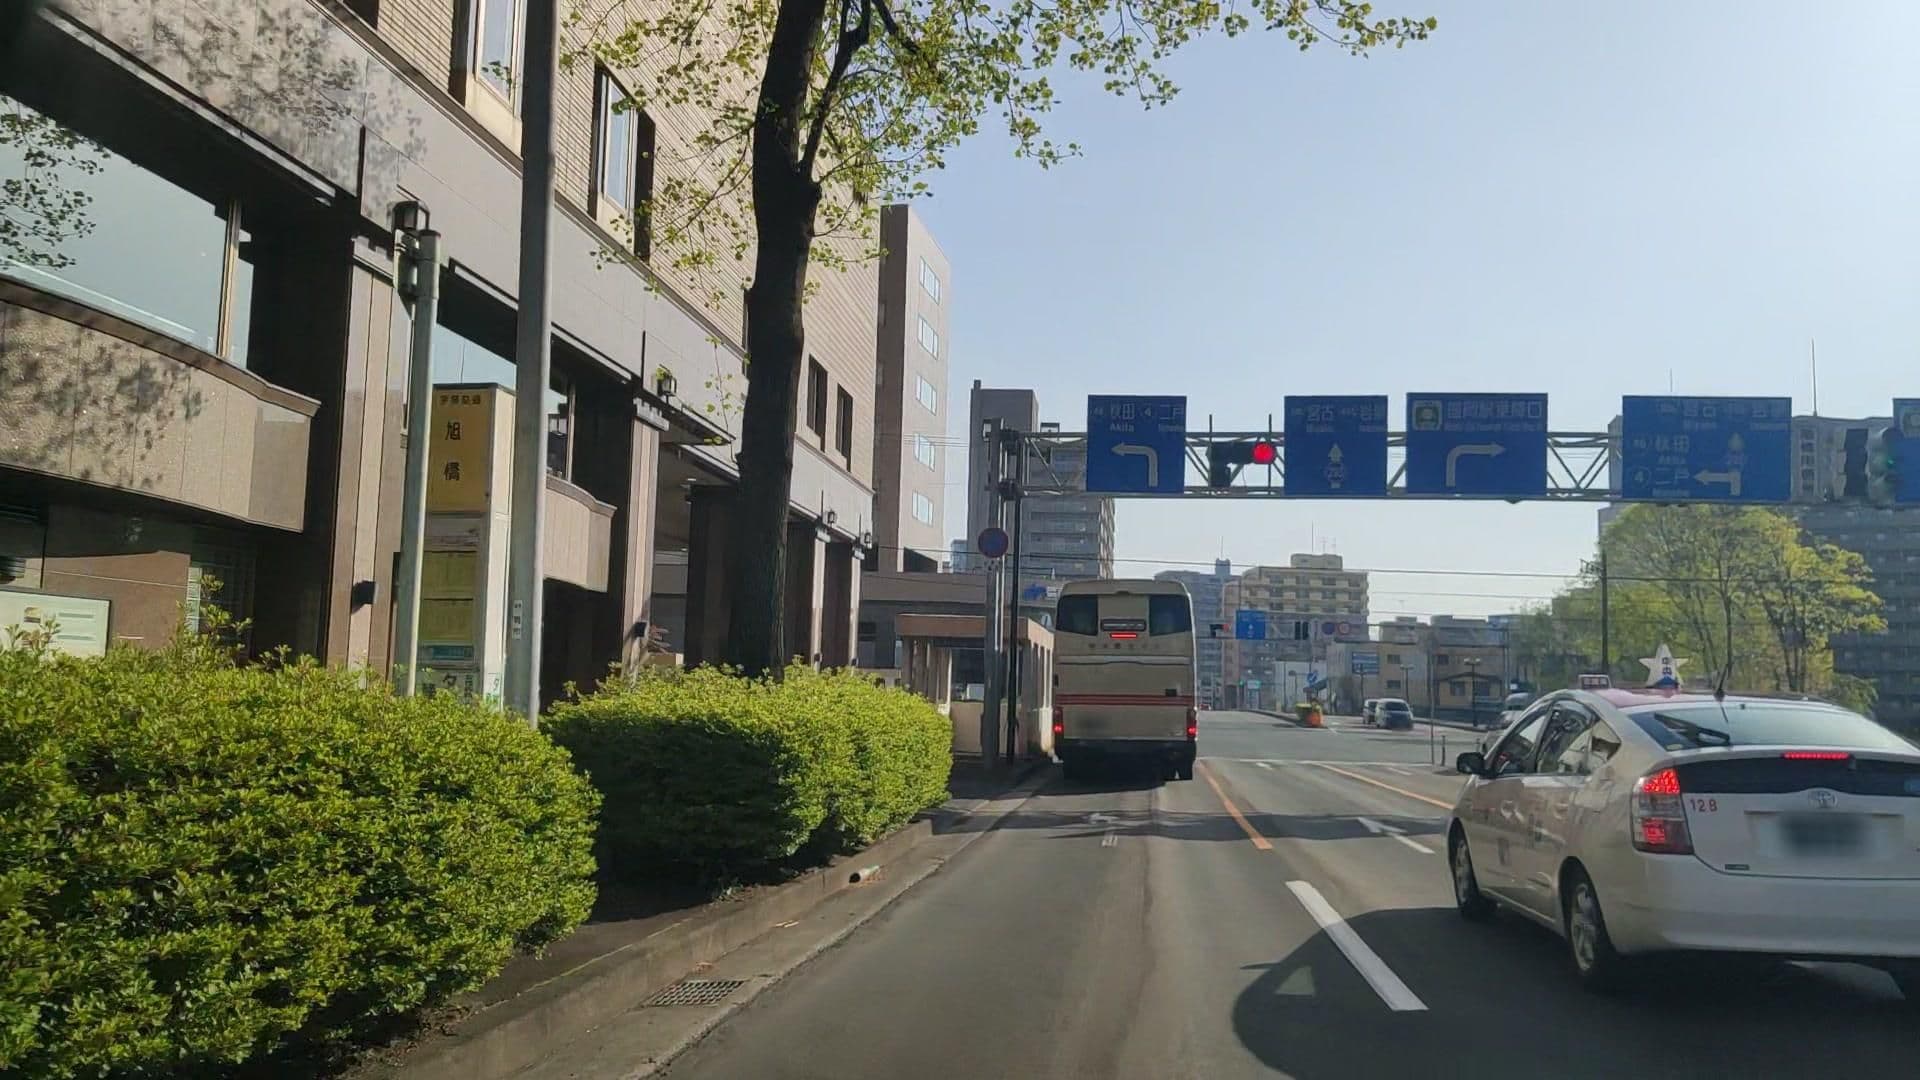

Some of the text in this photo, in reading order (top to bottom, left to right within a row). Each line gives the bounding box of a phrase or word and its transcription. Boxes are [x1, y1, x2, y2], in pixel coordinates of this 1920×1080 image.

[444, 421, 461, 481] 旭橋
[1655, 467, 1690, 485] 二戸
[1689, 798, 1718, 812] 128
